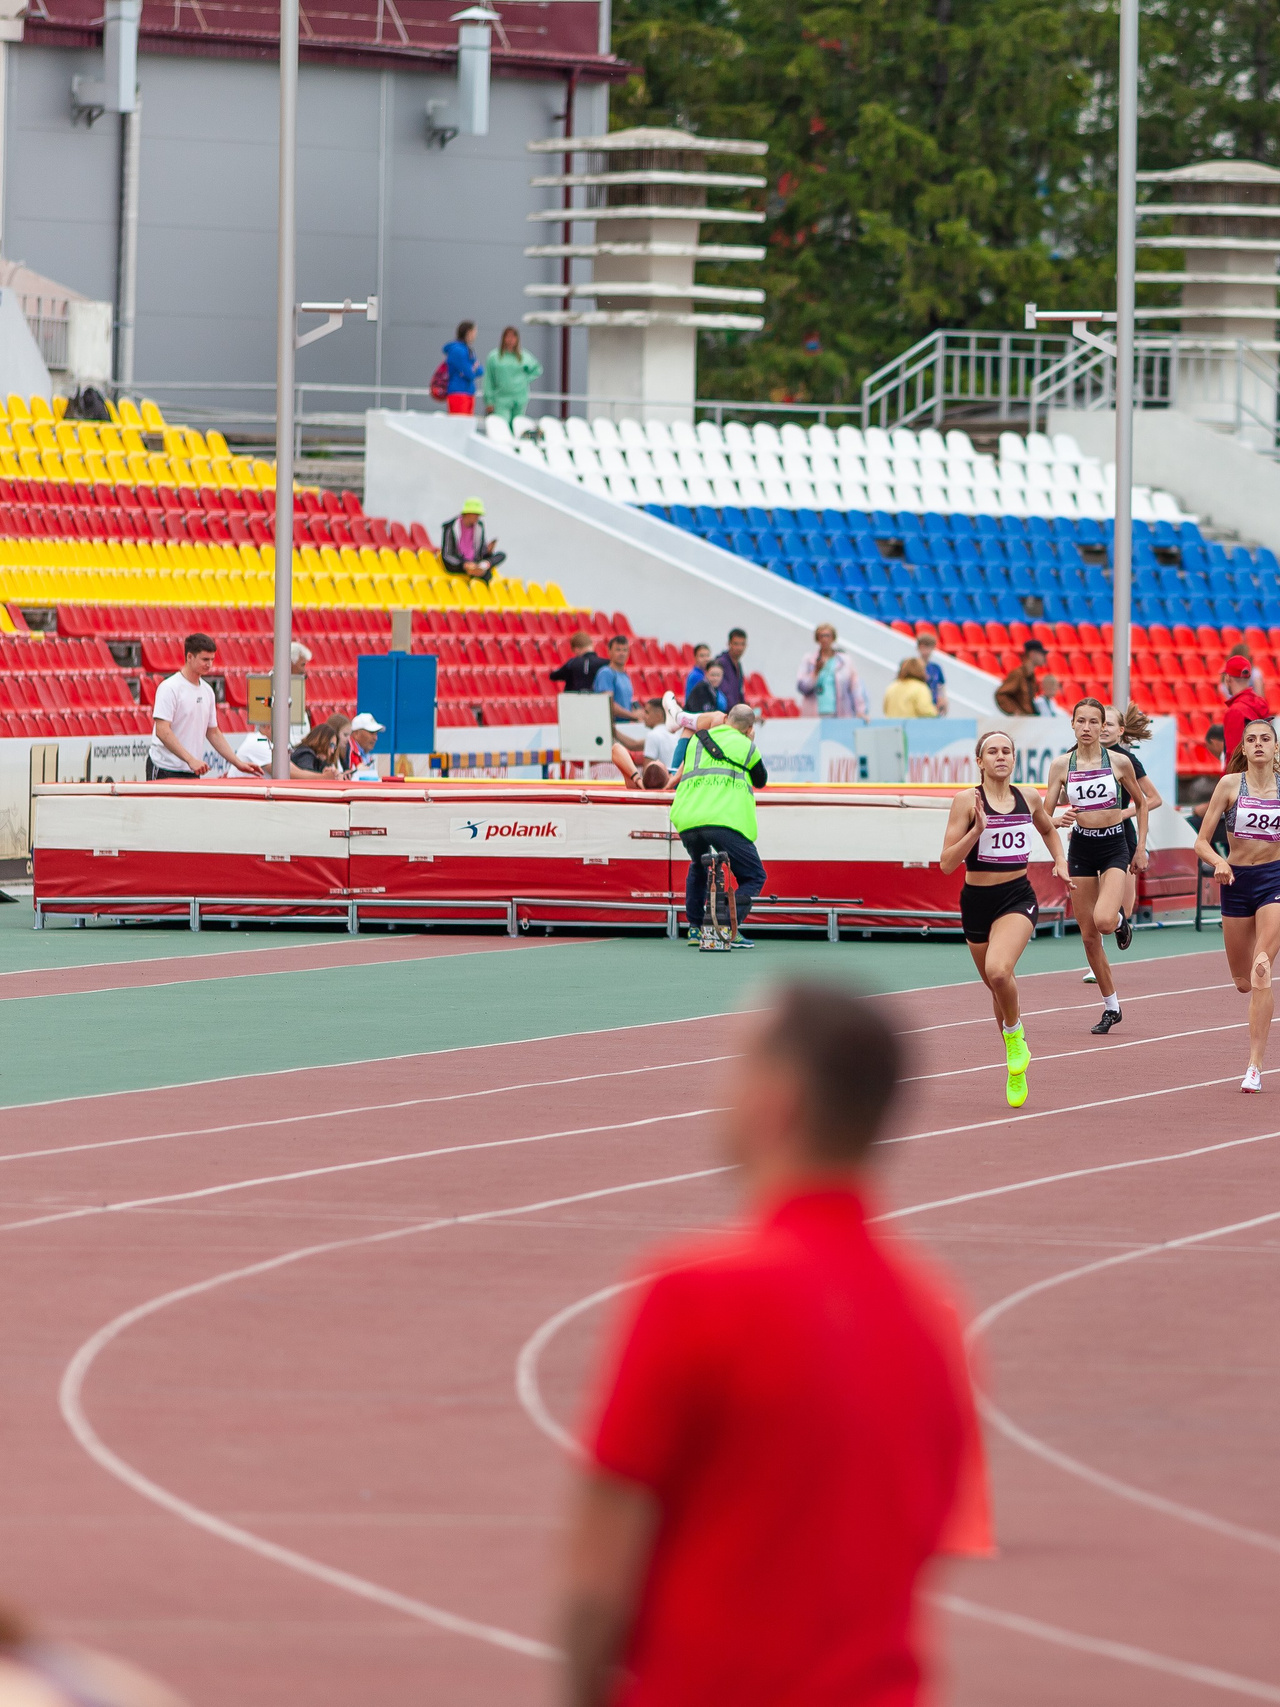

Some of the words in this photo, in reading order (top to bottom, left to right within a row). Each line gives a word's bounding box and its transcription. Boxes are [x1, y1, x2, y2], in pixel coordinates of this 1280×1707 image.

[1076, 783, 1108, 800] 162
[1245, 812, 1280, 830] 284
[485, 821, 558, 841] polanik
[991, 831, 1025, 849] 103
